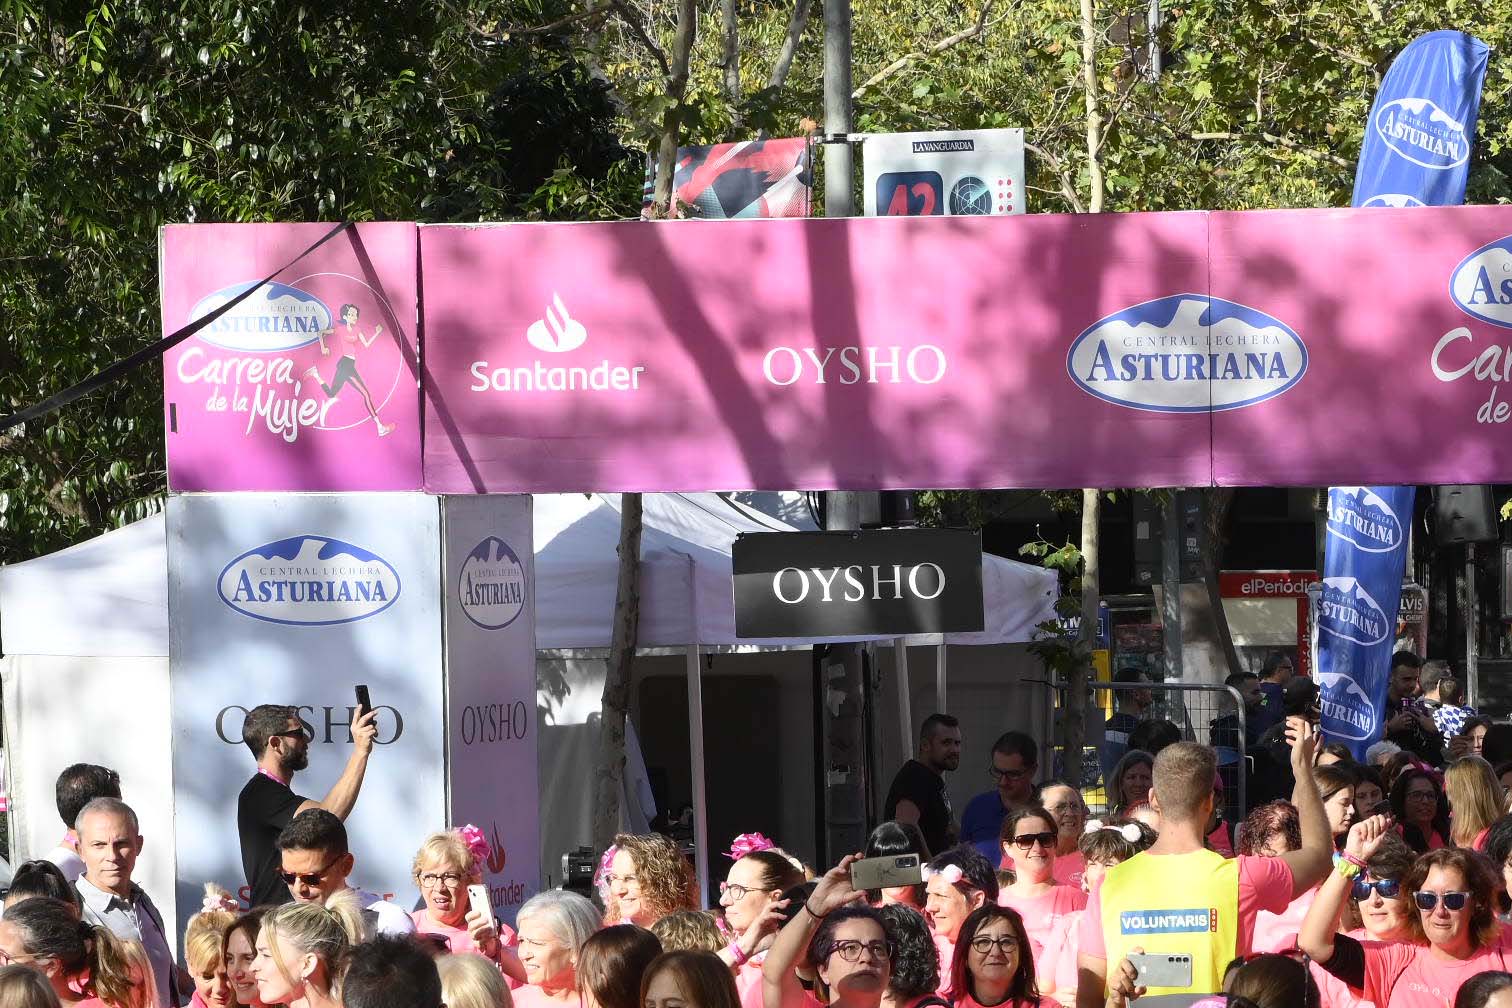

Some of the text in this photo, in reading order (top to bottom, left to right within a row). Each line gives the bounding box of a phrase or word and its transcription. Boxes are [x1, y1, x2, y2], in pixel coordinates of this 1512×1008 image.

[1382, 110, 1459, 161] ASTURIAN
[1085, 339, 1290, 382] ASTURIANA
[1123, 334, 1281, 348] CENTRAL LECHERA
[176, 346, 294, 385] Carrera
[470, 359, 646, 392] Santander
[762, 344, 947, 386] OYSHO
[205, 380, 338, 443] de la Mujer
[1476, 384, 1512, 424] de
[231, 569, 388, 603] ASTURIANA
[259, 566, 381, 577] CENTRAL LECHERA
[464, 572, 523, 606] ASTURIANA
[772, 562, 946, 604] OYSHO
[1400, 598, 1423, 611] LVIS
[215, 705, 404, 746] OSHO
[461, 700, 527, 746] OYSHO
[1121, 914, 1208, 929] VOLUNTARIS
